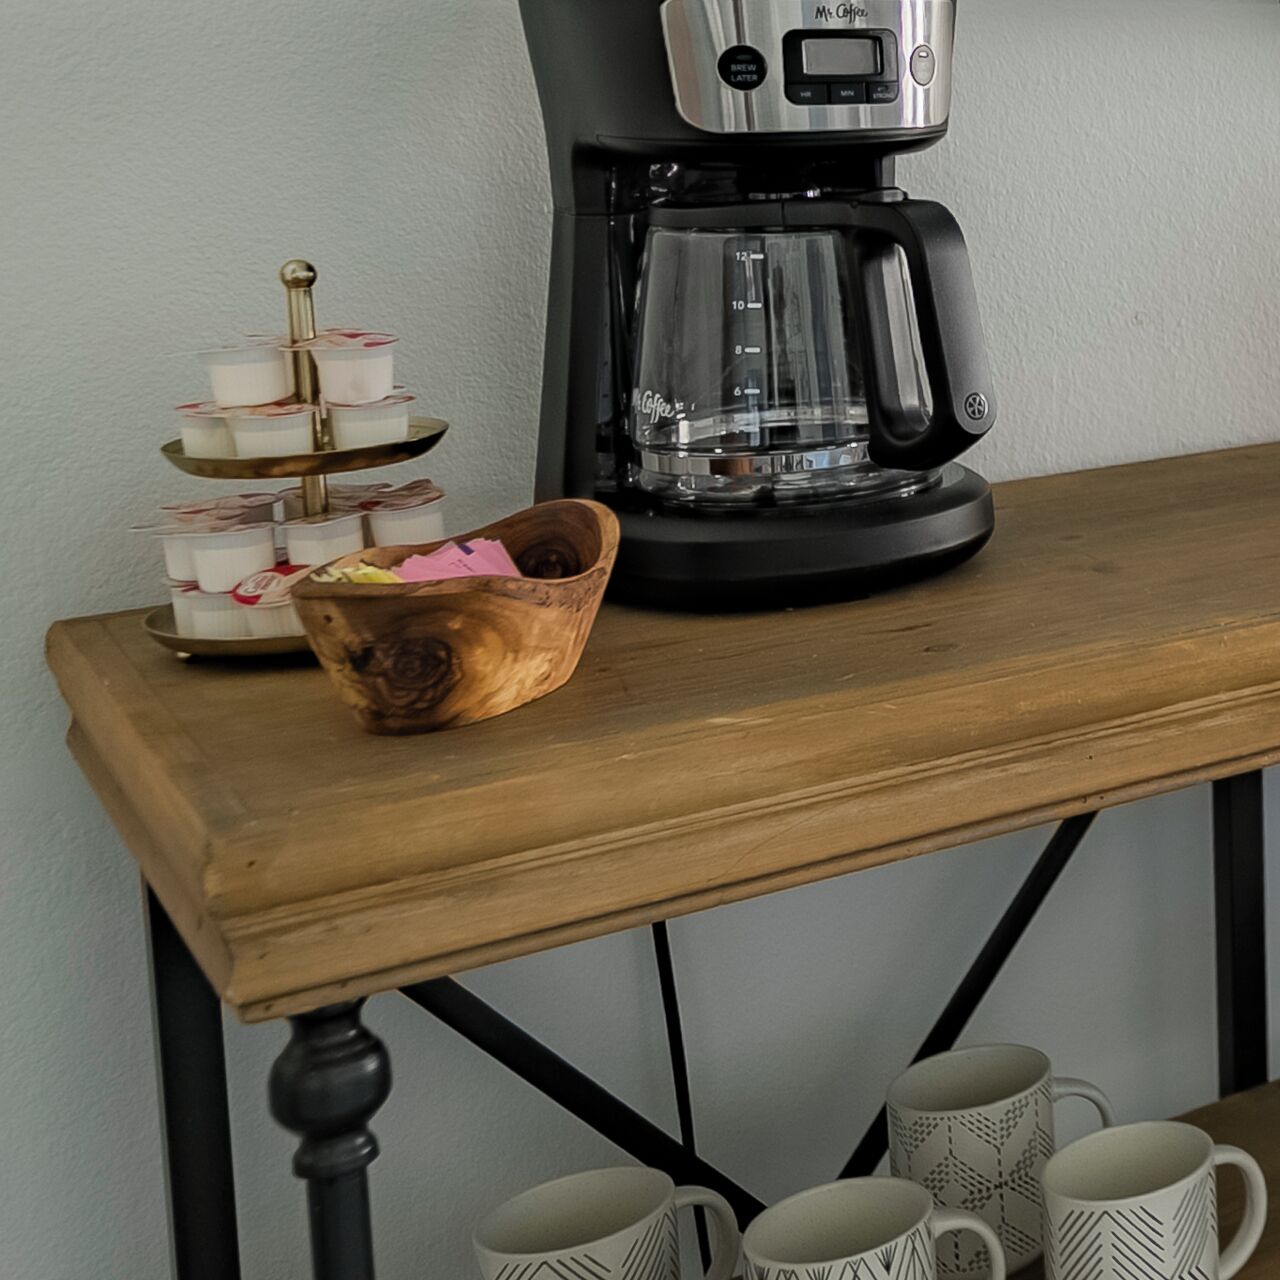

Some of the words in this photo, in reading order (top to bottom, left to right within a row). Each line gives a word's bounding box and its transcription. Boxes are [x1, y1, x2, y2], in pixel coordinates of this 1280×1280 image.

[836, 3, 868, 24] Coffee
[730, 63, 757, 72] BREW
[730, 74, 758, 82] LATER
[735, 251, 747, 261] 12
[732, 300, 745, 310] 10
[734, 345, 742, 355] 8
[734, 387, 741, 396] 6
[641, 389, 675, 424] Coffee
